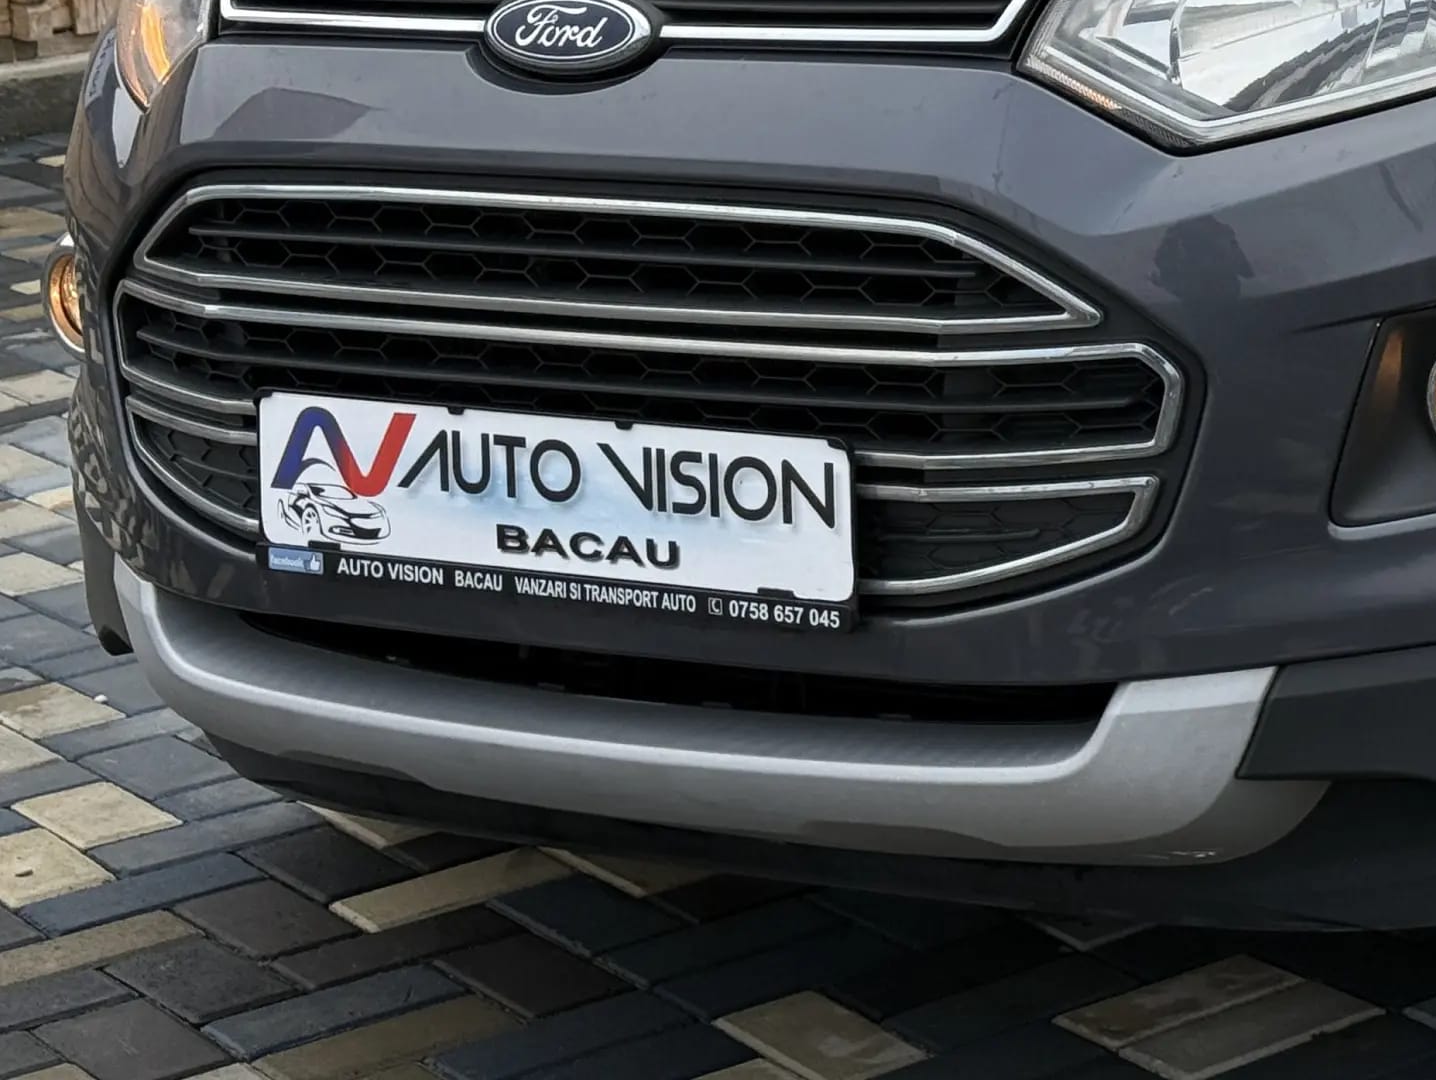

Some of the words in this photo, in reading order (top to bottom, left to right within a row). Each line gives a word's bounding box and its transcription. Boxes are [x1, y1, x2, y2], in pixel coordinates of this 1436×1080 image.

[515, 4, 608, 48] Ford
[398, 430, 582, 503] AUTO
[597, 442, 835, 530] VISION
[496, 522, 681, 570] BACAU
[337, 557, 384, 578] AUTO
[388, 563, 444, 586] VISION
[455, 571, 503, 592] BACAU
[514, 576, 567, 600] VANZARI
[569, 582, 582, 600] SI
[584, 583, 660, 609] TRANSPORT
[661, 596, 697, 613] AUTO
[729, 599, 769, 620] 0758
[773, 604, 804, 624] 657
[809, 608, 841, 629] 045
